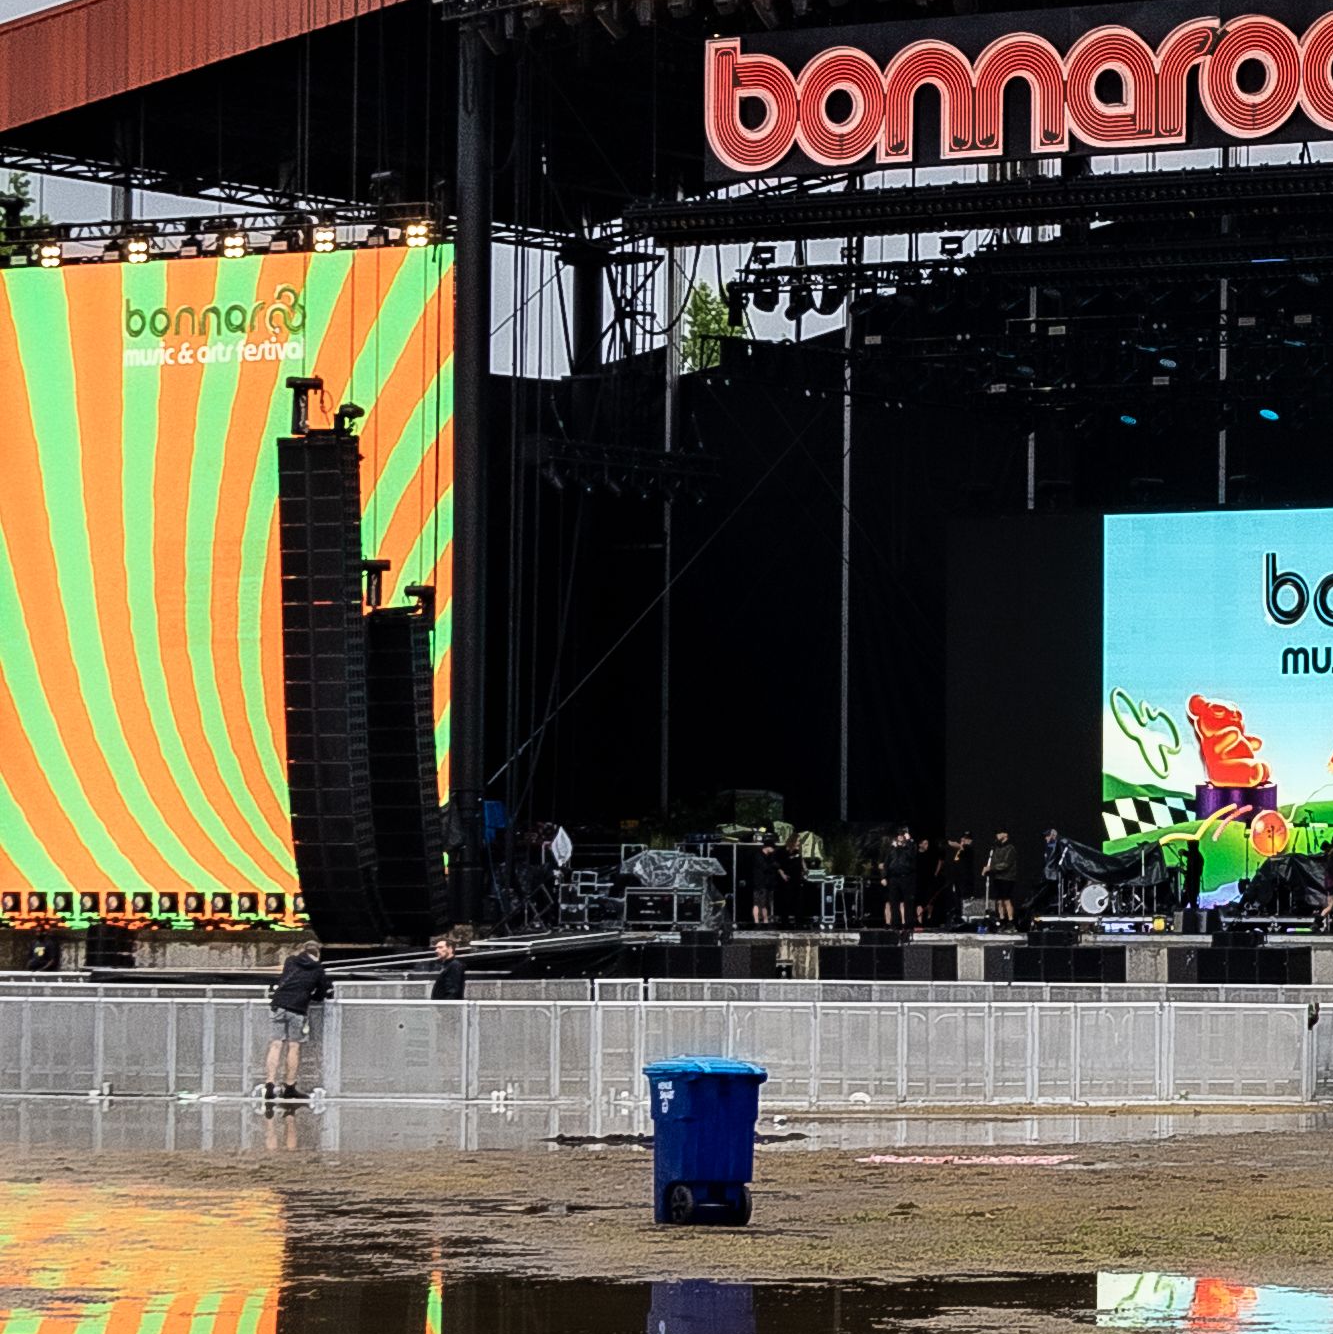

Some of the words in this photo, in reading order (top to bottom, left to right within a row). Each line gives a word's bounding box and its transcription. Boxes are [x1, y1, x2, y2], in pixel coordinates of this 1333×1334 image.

[124, 341, 175, 368] music
[178, 342, 194, 365] &
[197, 342, 234, 364] arts
